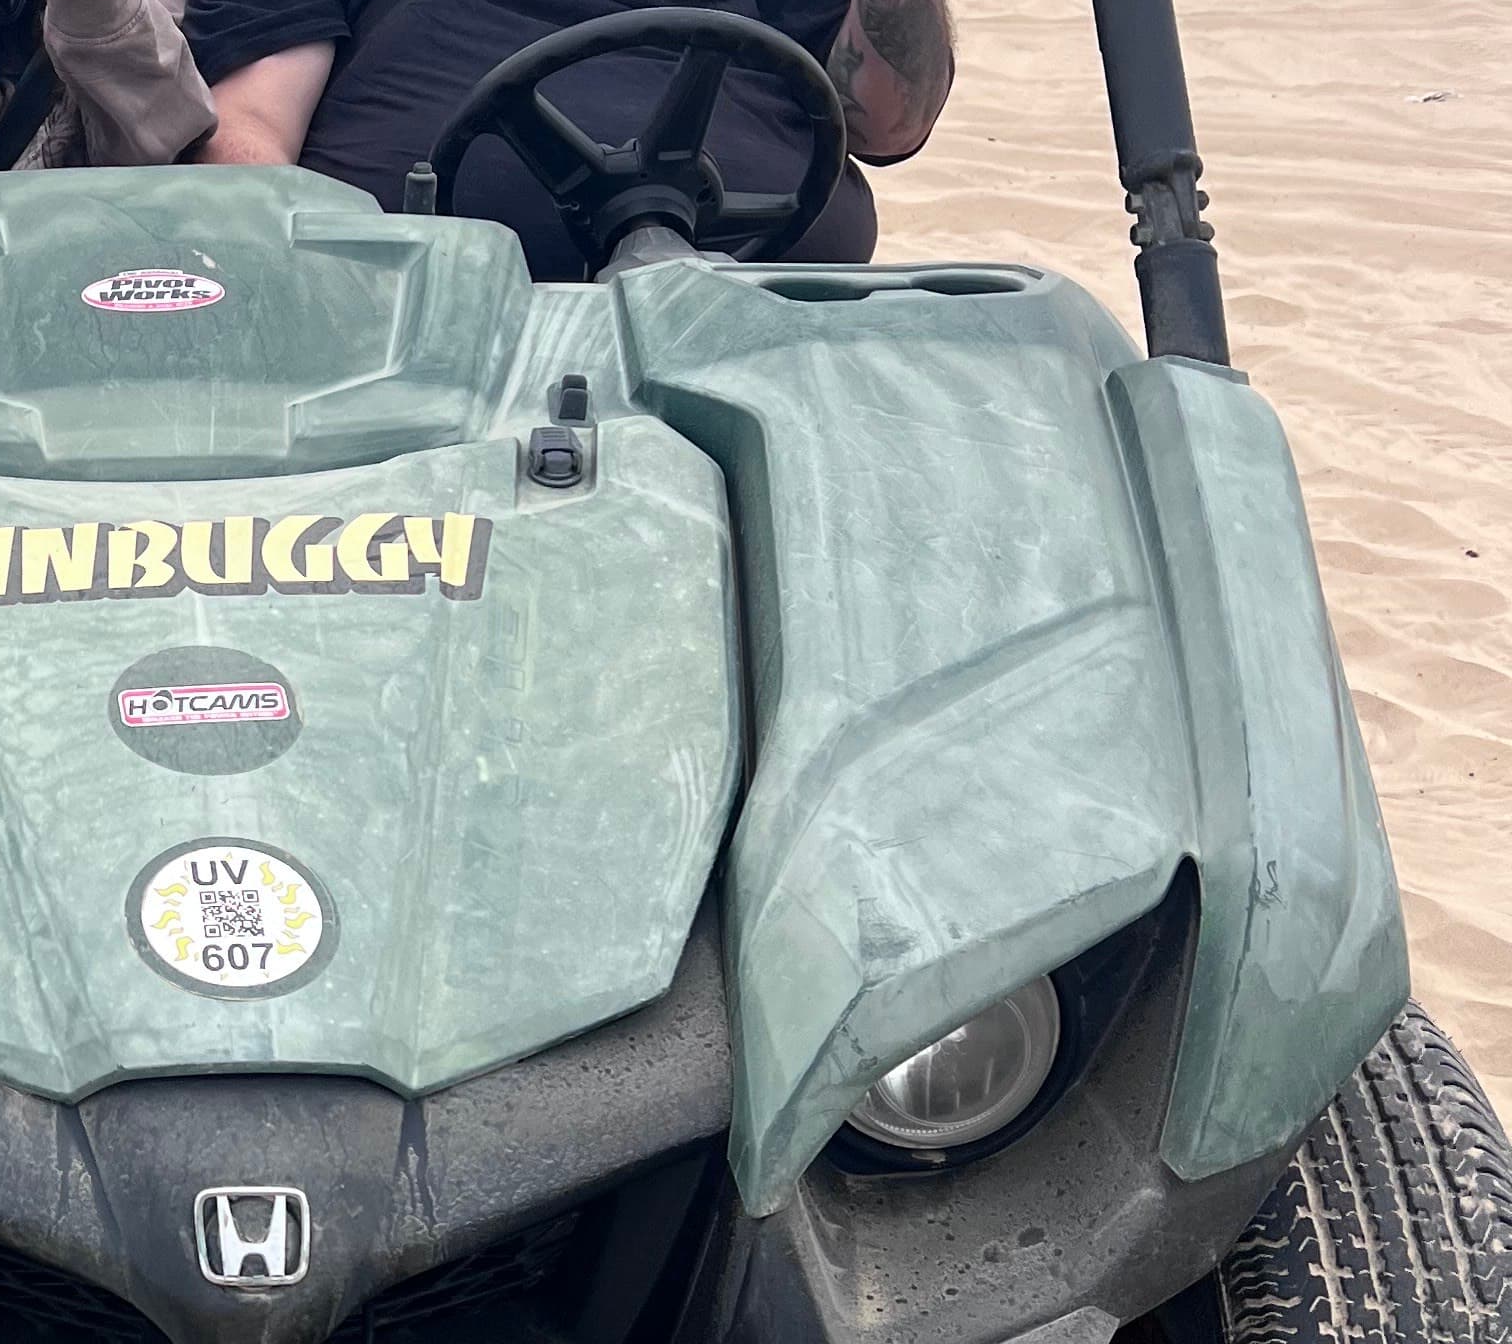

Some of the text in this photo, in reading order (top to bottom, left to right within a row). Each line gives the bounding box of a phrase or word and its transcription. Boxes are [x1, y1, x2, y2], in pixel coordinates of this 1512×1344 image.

[111, 278, 197, 290] Pivot
[100, 289, 211, 302] Works
[190, 859, 248, 886] UV
[201, 943, 274, 971] 607
